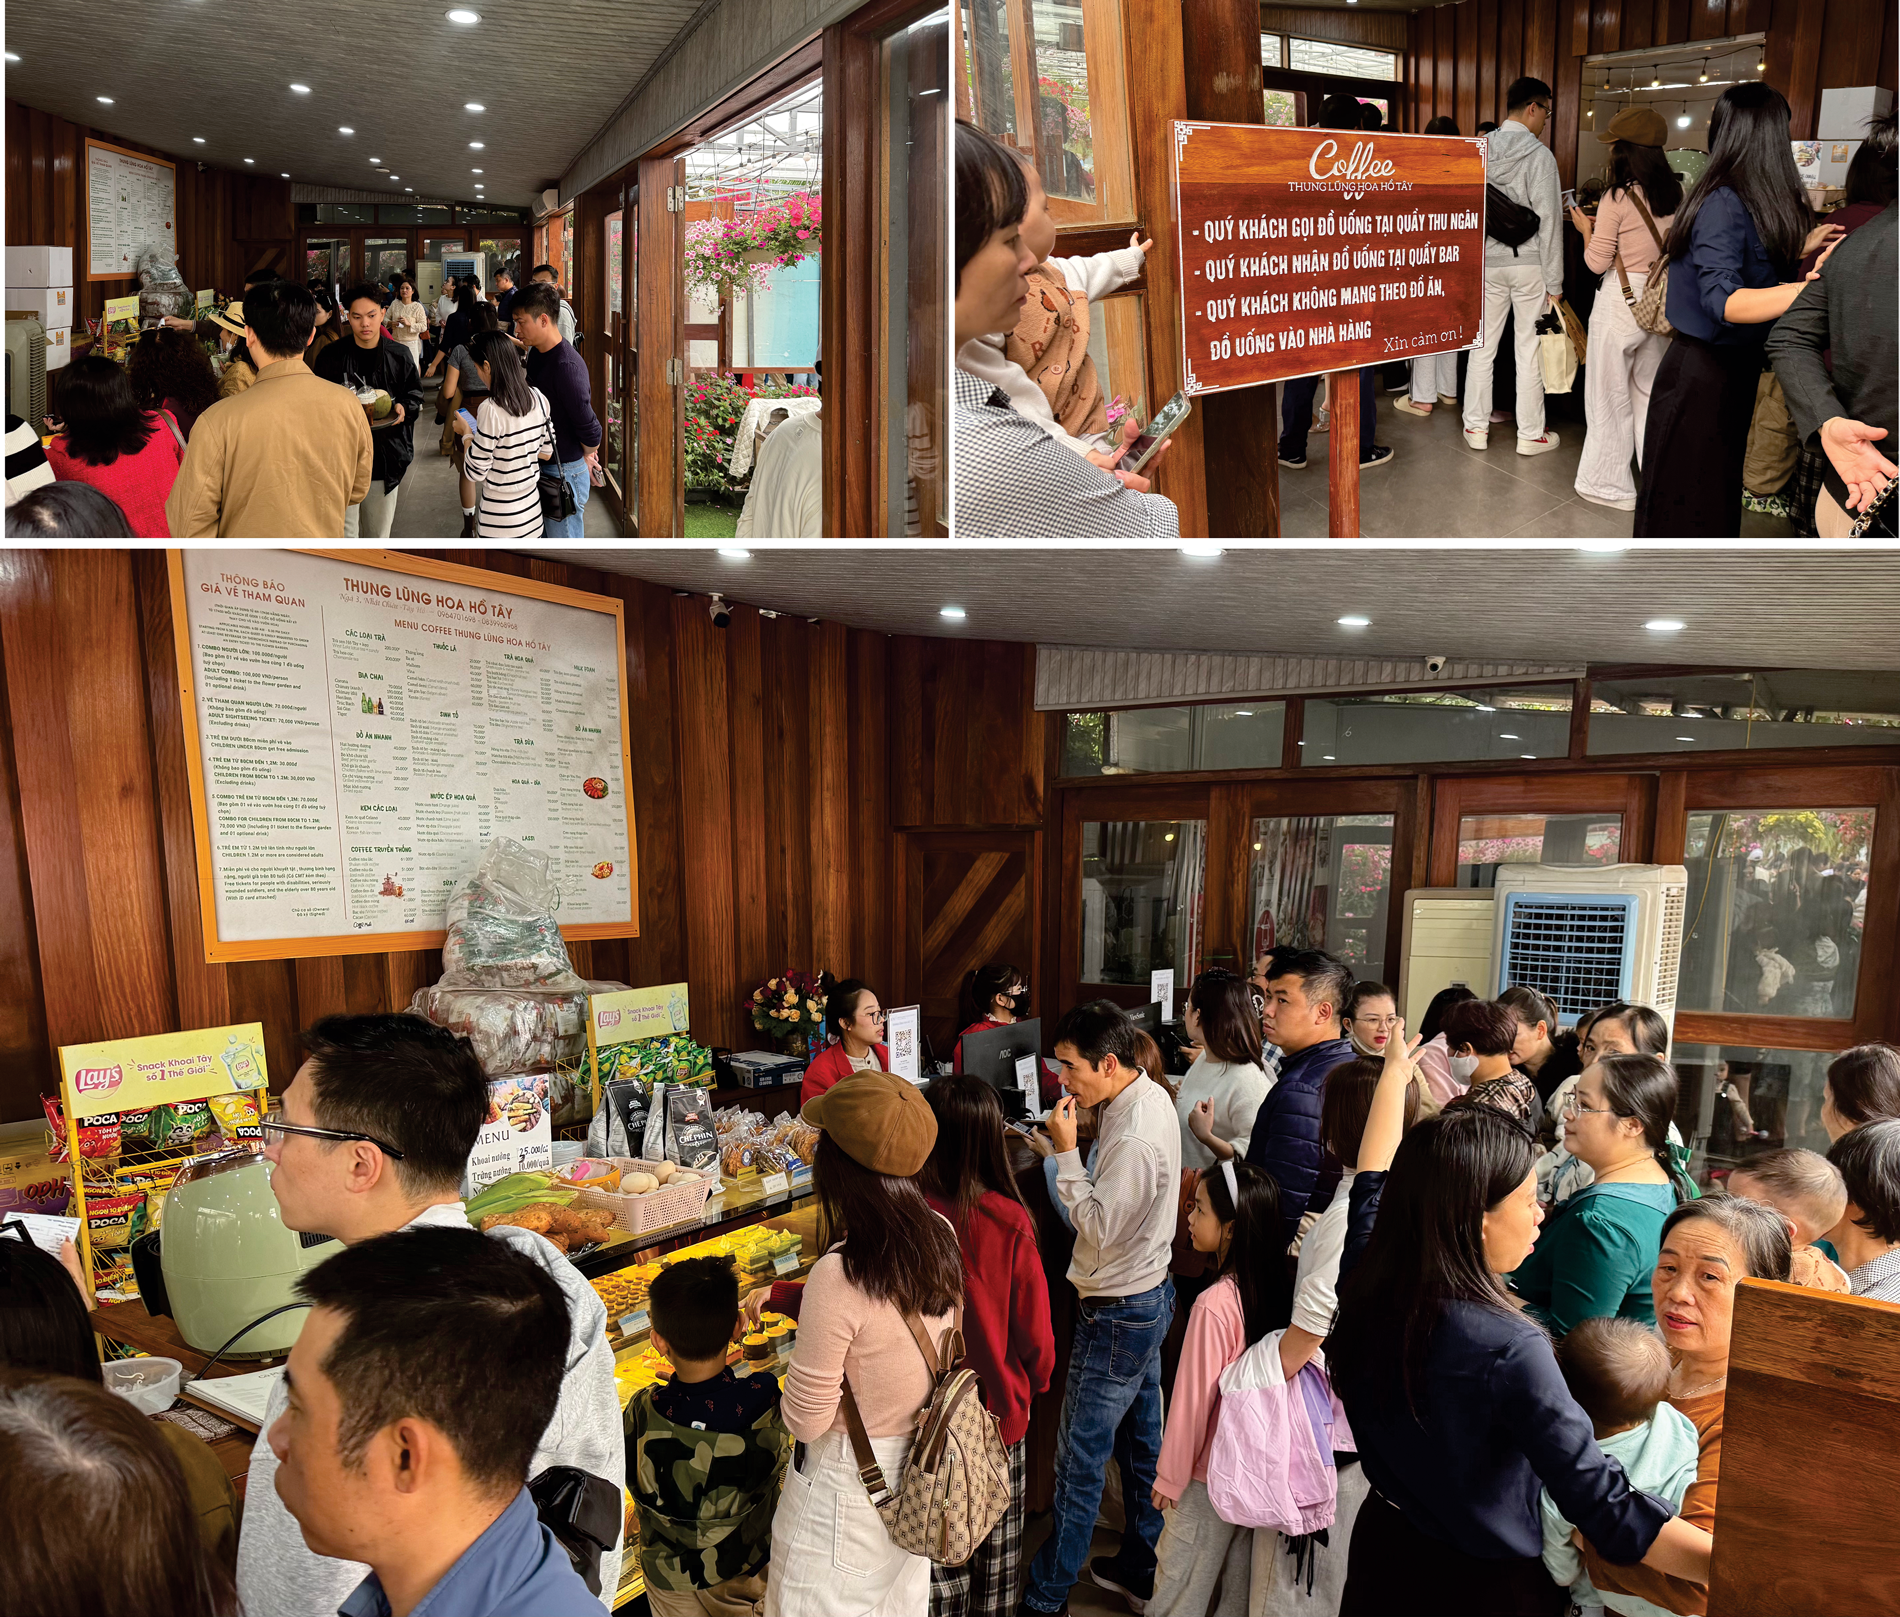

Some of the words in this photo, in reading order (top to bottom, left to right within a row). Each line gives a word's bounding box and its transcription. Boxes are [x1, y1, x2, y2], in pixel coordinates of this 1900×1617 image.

[1309, 140, 1396, 200] Coffee
[1288, 182, 1327, 192] THUNG
[1328, 180, 1356, 191] LŨNG
[1358, 182, 1379, 191] HOA
[1380, 179, 1394, 190] HỒ
[1396, 180, 1413, 190] TÂY
[1204, 216, 1234, 241] QUÝ
[1239, 214, 1288, 240] KHÁCH
[1292, 217, 1314, 240] GỌI
[1317, 211, 1335, 235] ĐỒ
[1339, 209, 1372, 235] UỐNG
[1376, 215, 1393, 234] TẠI
[1396, 209, 1424, 234] QUẦY
[1428, 214, 1448, 230] THU
[1450, 210, 1478, 230] NGÂN
[1205, 254, 1234, 282] QUÝ
[1240, 253, 1288, 278] KHÁCH
[1292, 250, 1329, 276] NHẬN
[1333, 245, 1350, 270] ĐỒ
[1353, 244, 1384, 269] UỐNG
[1388, 250, 1405, 270] TẠI
[1409, 242, 1436, 264] QUẦY
[1439, 245, 1460, 262] BAR
[1206, 294, 1236, 322] QUÝ
[1241, 290, 1288, 317] KHÁCH
[1293, 288, 1337, 311] KHÔNG
[1341, 284, 1376, 304] MANG
[1380, 282, 1407, 301] THEO
[1410, 275, 1425, 298] ĐỒ
[1428, 275, 1445, 297] ĂN,
[1210, 333, 1231, 360] ĐỒ
[1236, 328, 1275, 355] UỐNG
[1279, 325, 1305, 349] VÀO
[1309, 323, 1335, 346] NHÀ
[1338, 320, 1372, 341] HÀNG
[1384, 337, 1408, 353] Xin
[1412, 331, 1438, 347] cảm
[220, 573, 259, 588] THÔNG
[262, 579, 285, 592] BÁO
[200, 582, 222, 594] GIÁ
[242, 590, 272, 602] THAM
[274, 595, 305, 608] QUAN
[344, 577, 391, 598] THUNG
[396, 586, 432, 605] LŨNG
[436, 594, 465, 611] HOA
[469, 598, 487, 615] HỒ
[491, 604, 513, 619] TÂY
[346, 629, 358, 637] CÁC
[395, 619, 418, 630] MENU
[421, 624, 452, 635] COFFEE
[454, 629, 481, 640] THUNG
[484, 633, 504, 643] LŨNG
[507, 638, 523, 647] HOA
[202, 644, 220, 652] COMBO
[137, 1061, 166, 1071] Snack
[168, 1058, 195, 1067] Khoai
[197, 1054, 212, 1065] Tây
[146, 1071, 157, 1081] số
[159, 1070, 166, 1080] 1
[168, 1067, 184, 1078] Thế
[187, 1066, 206, 1075] Giới
[83, 1114, 117, 1126] POCA
[237, 1127, 262, 1136] POCA
[475, 1130, 509, 1145] MENU
[472, 1156, 490, 1166] Khoai
[492, 1153, 510, 1161] nướng
[472, 1170, 492, 1182] Trứng
[493, 1167, 511, 1176] nướng
[24, 1176, 66, 1204] Hảo
[90, 1218, 126, 1228] POCA
